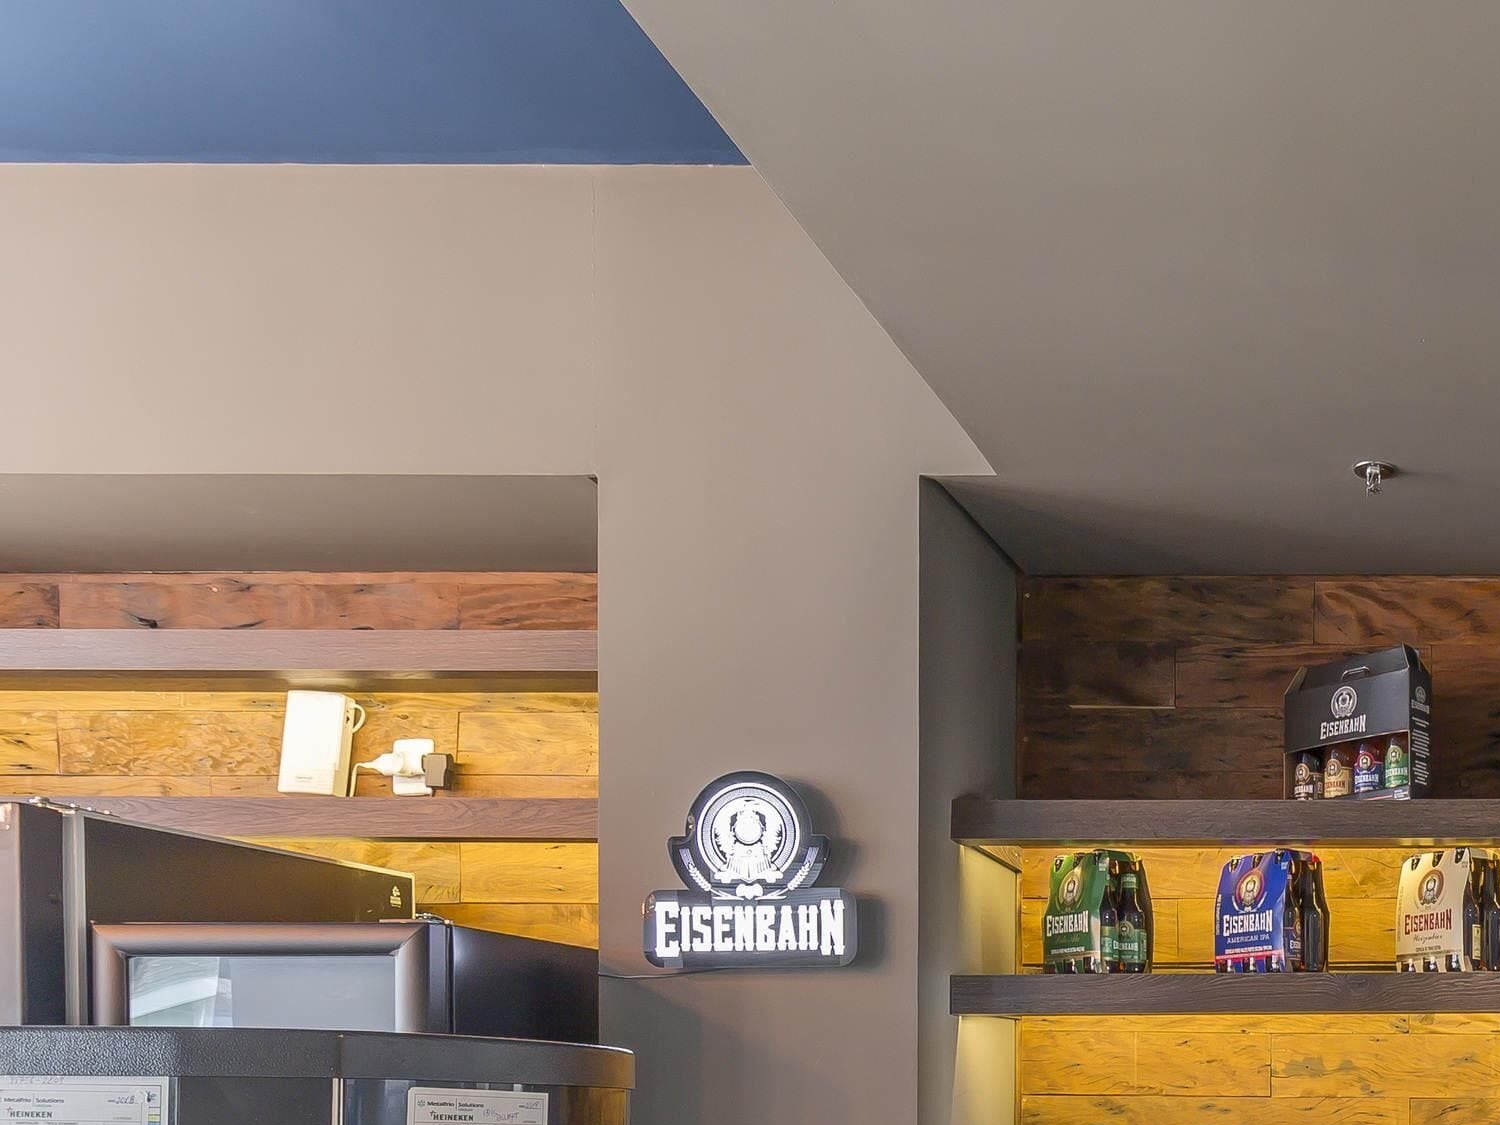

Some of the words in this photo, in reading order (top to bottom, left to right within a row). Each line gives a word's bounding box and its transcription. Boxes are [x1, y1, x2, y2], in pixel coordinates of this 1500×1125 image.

[1320, 714, 1367, 740] EISENBAHN
[655, 899, 845, 957] EISENBAHN
[1046, 910, 1089, 937] EISENBAHN
[1223, 909, 1273, 937] EISENBAHN
[1404, 908, 1452, 935] EISENBAHN
[9, 1110, 53, 1118] HEINEKEN
